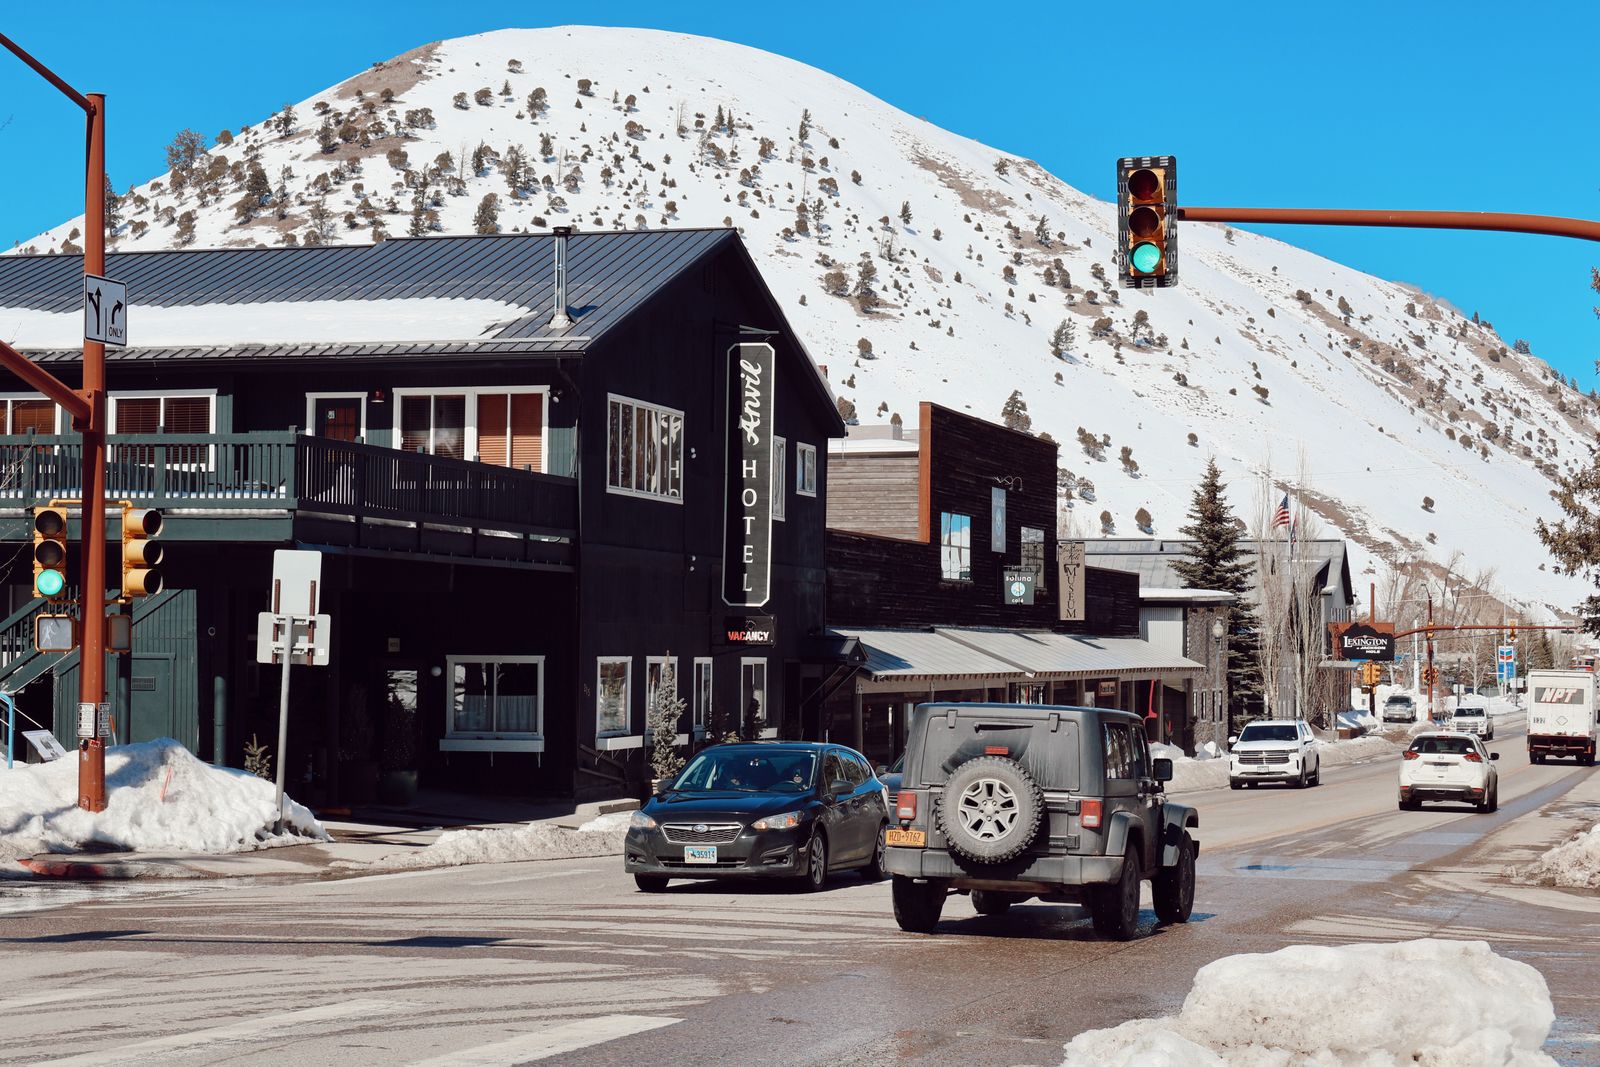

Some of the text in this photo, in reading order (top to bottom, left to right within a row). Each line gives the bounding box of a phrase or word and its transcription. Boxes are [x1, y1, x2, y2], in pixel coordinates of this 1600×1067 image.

[109, 327, 123, 338] ONLY
[738, 359, 762, 446] Anvil
[741, 459, 758, 592] HOTEL
[1065, 566, 1077, 619] MUSEUM
[728, 631, 770, 642] VACANCY
[1343, 635, 1388, 648] LEXINGTON
[1540, 687, 1578, 703] NPT
